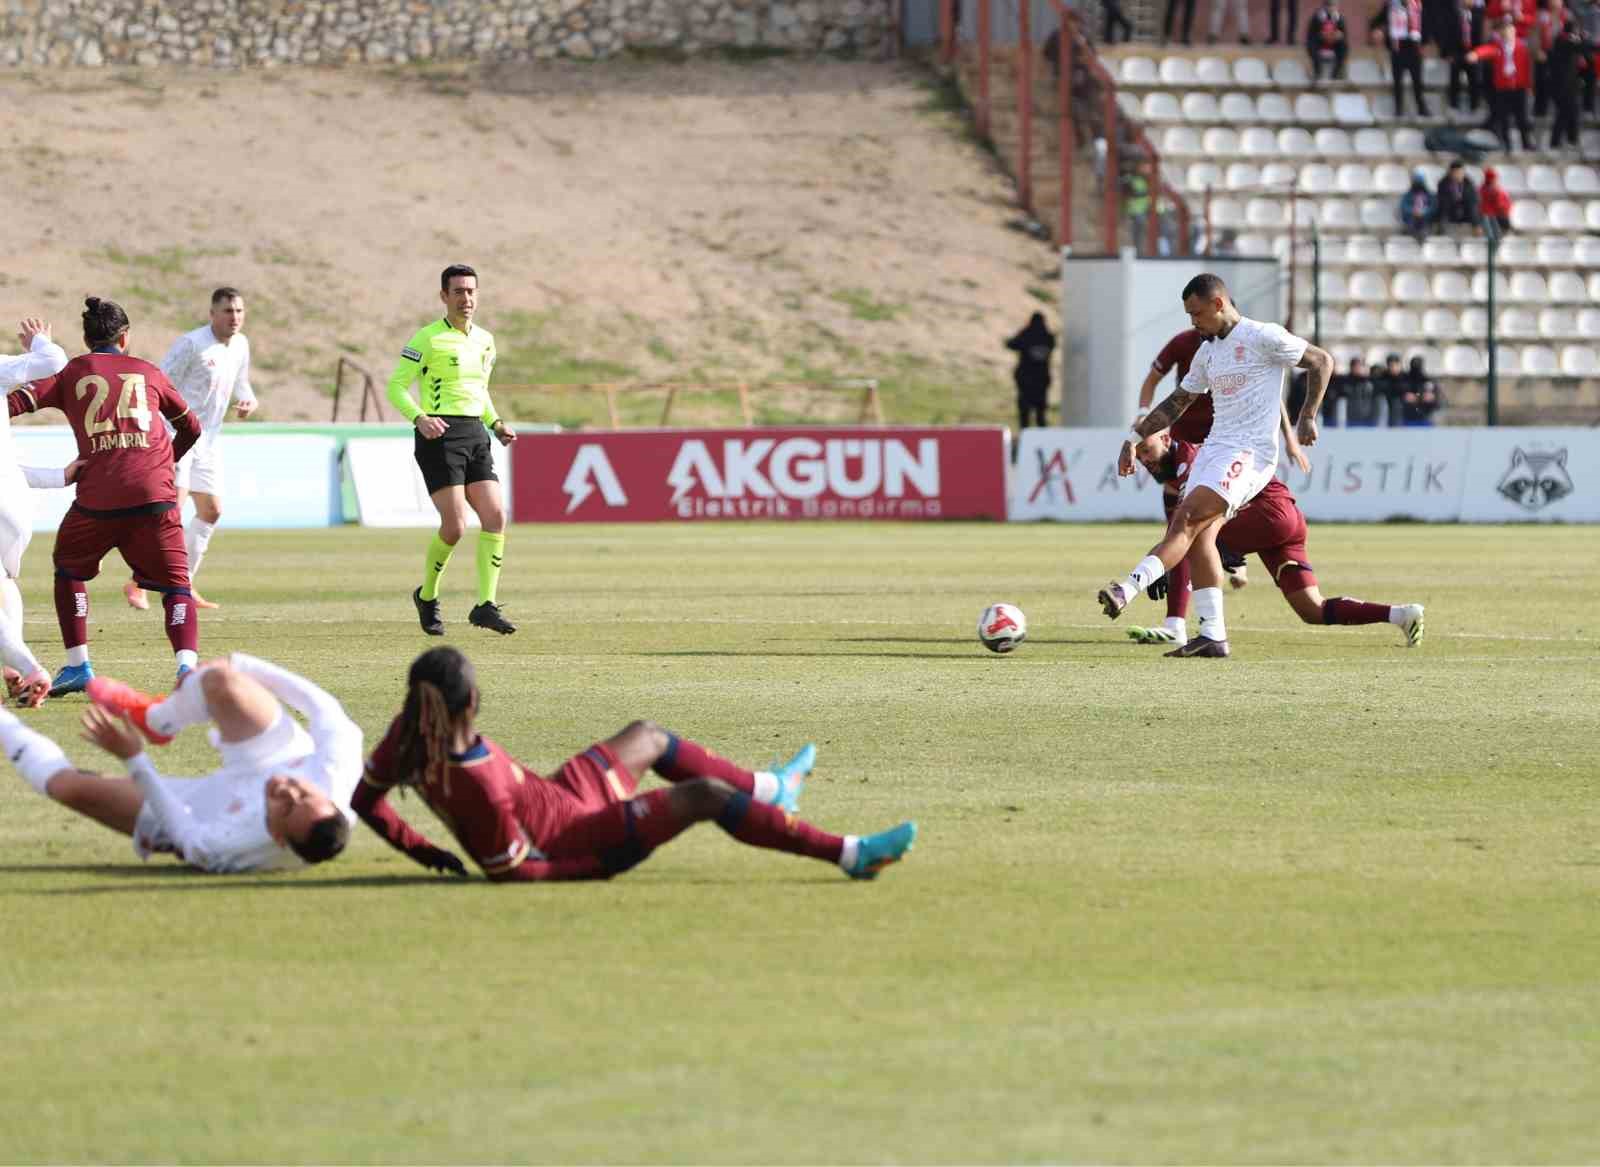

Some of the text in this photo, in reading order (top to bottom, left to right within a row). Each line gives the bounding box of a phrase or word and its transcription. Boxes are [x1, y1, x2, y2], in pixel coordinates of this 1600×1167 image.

[75, 373, 152, 437] 24
[667, 438, 940, 502] AKGÜN
[1227, 461, 1243, 479] 9
[678, 498, 790, 517] Elektrik
